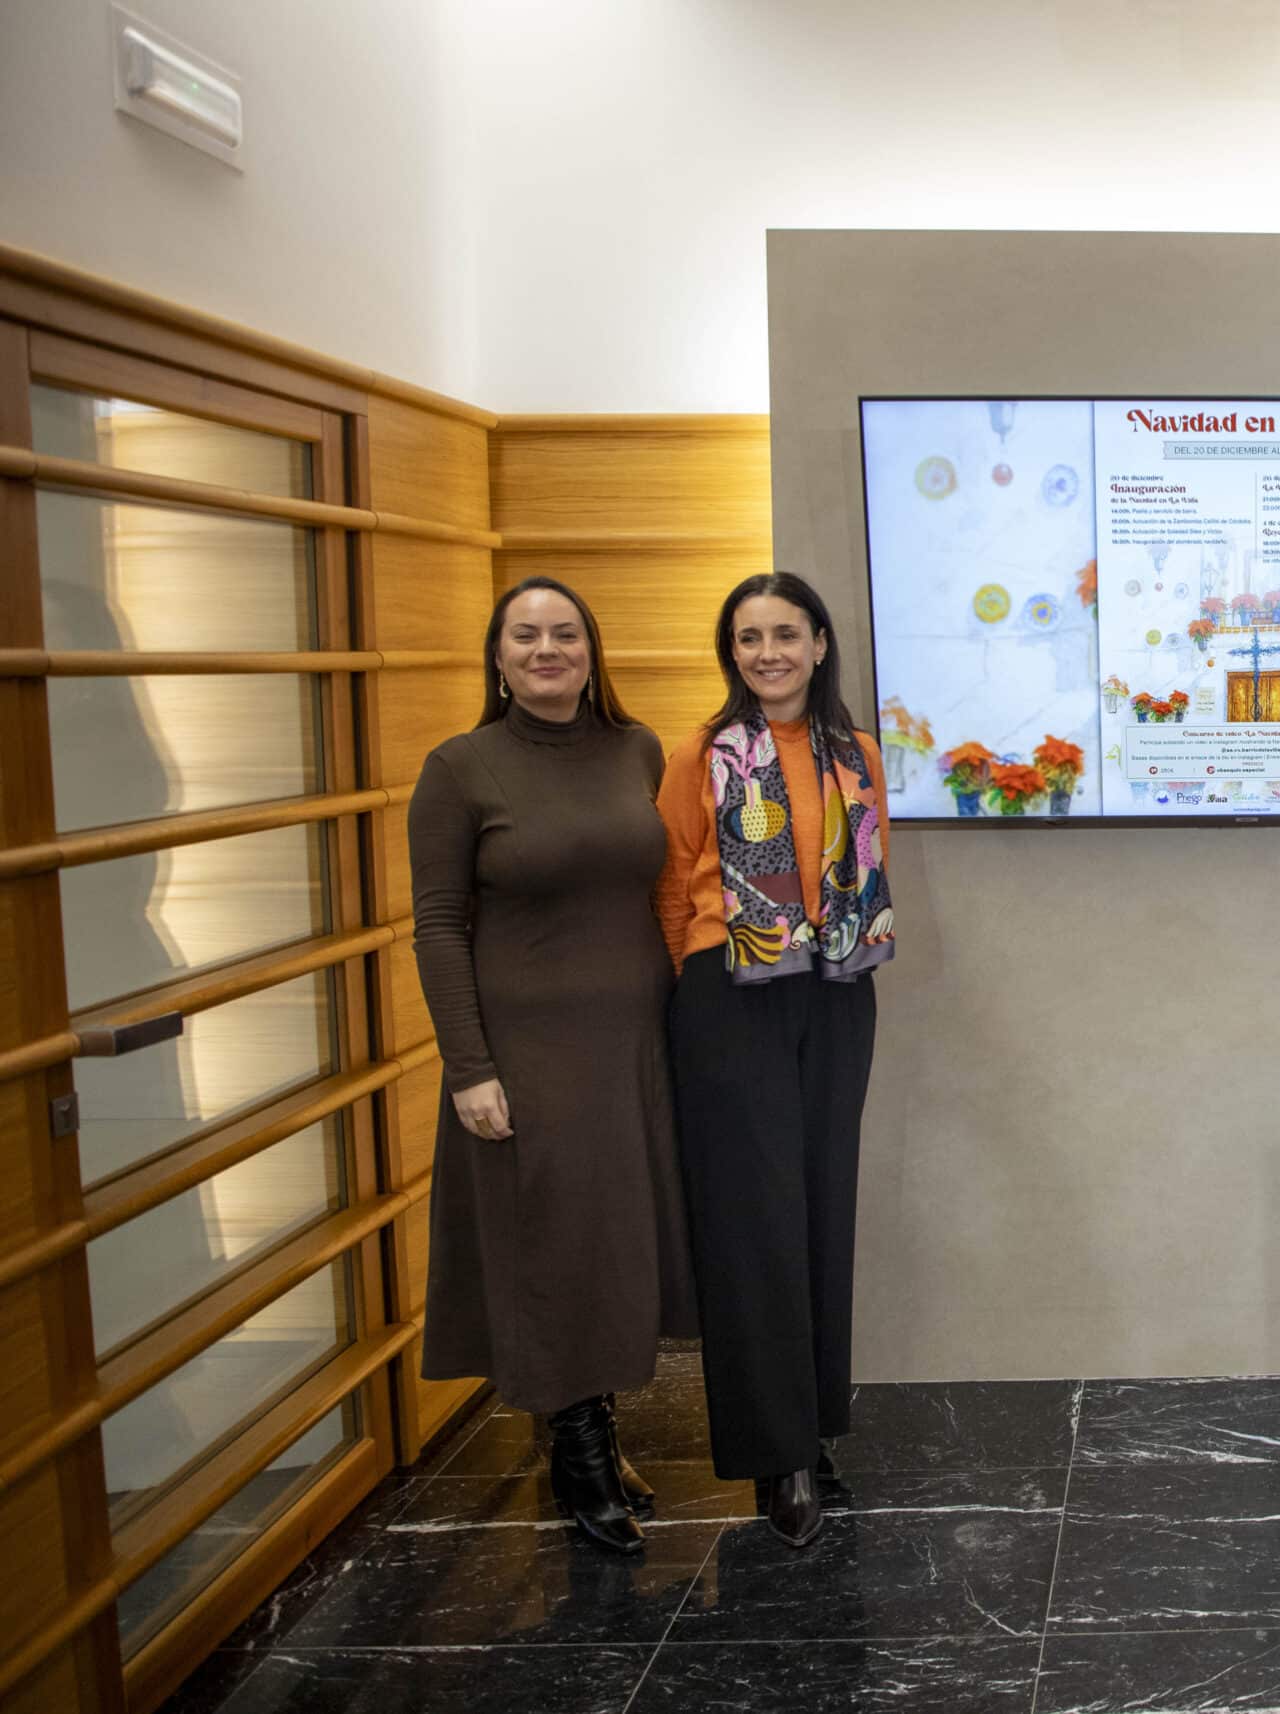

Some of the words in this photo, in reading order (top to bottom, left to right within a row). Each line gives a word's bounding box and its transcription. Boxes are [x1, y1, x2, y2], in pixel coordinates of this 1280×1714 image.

[1127, 409, 1237, 433] Navidad
[1245, 415, 1275, 432] en
[1174, 447, 1192, 455] DEL
[1193, 447, 1205, 455] 20
[1207, 447, 1219, 455] DE
[1221, 447, 1270, 455] DICIEMBRE
[1111, 483, 1186, 495] Inauguración
